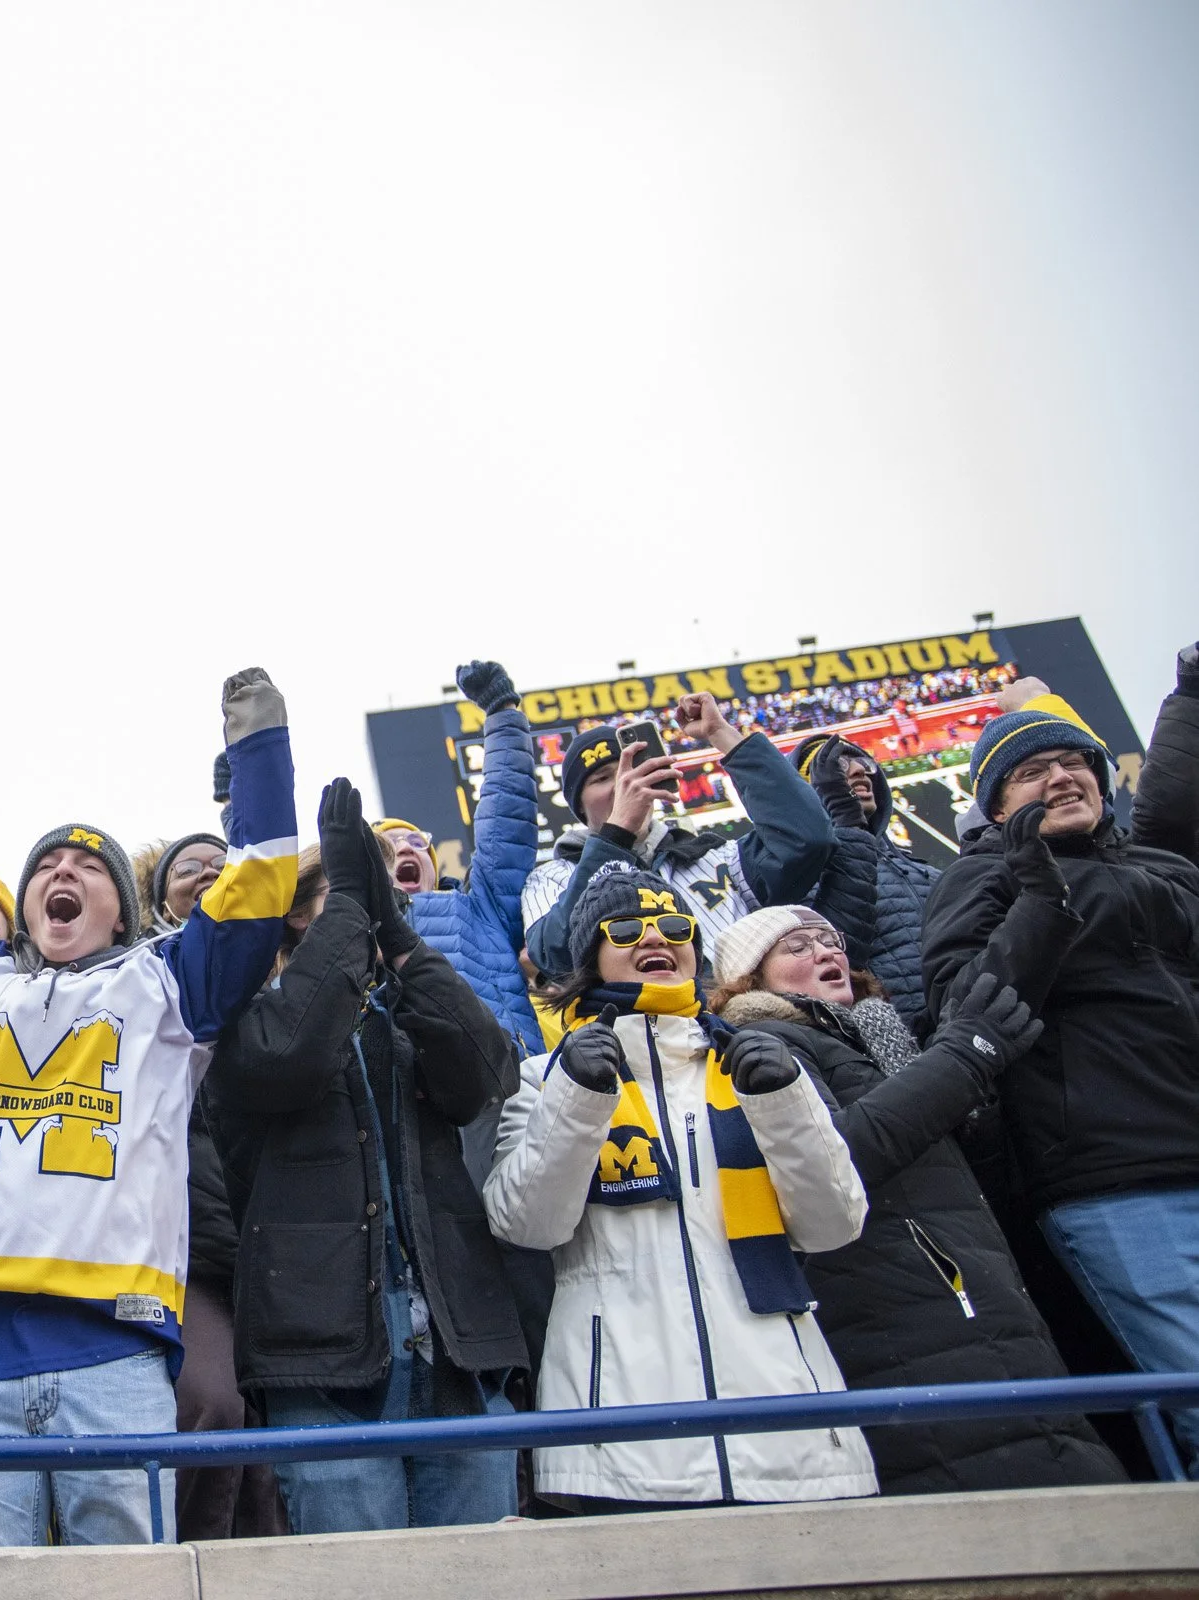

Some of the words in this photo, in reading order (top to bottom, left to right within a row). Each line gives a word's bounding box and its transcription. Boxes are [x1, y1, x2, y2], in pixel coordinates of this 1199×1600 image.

[456, 668, 733, 733] MCHIGAN
[741, 632, 1000, 694] STADIUM
[581, 741, 612, 768] M
[67, 828, 104, 849] M
[688, 863, 738, 910] M
[638, 888, 678, 913] M
[78, 1094, 113, 1114] CLUB
[598, 1136, 659, 1182] M
[600, 1176, 660, 1193] ENGINEERING
